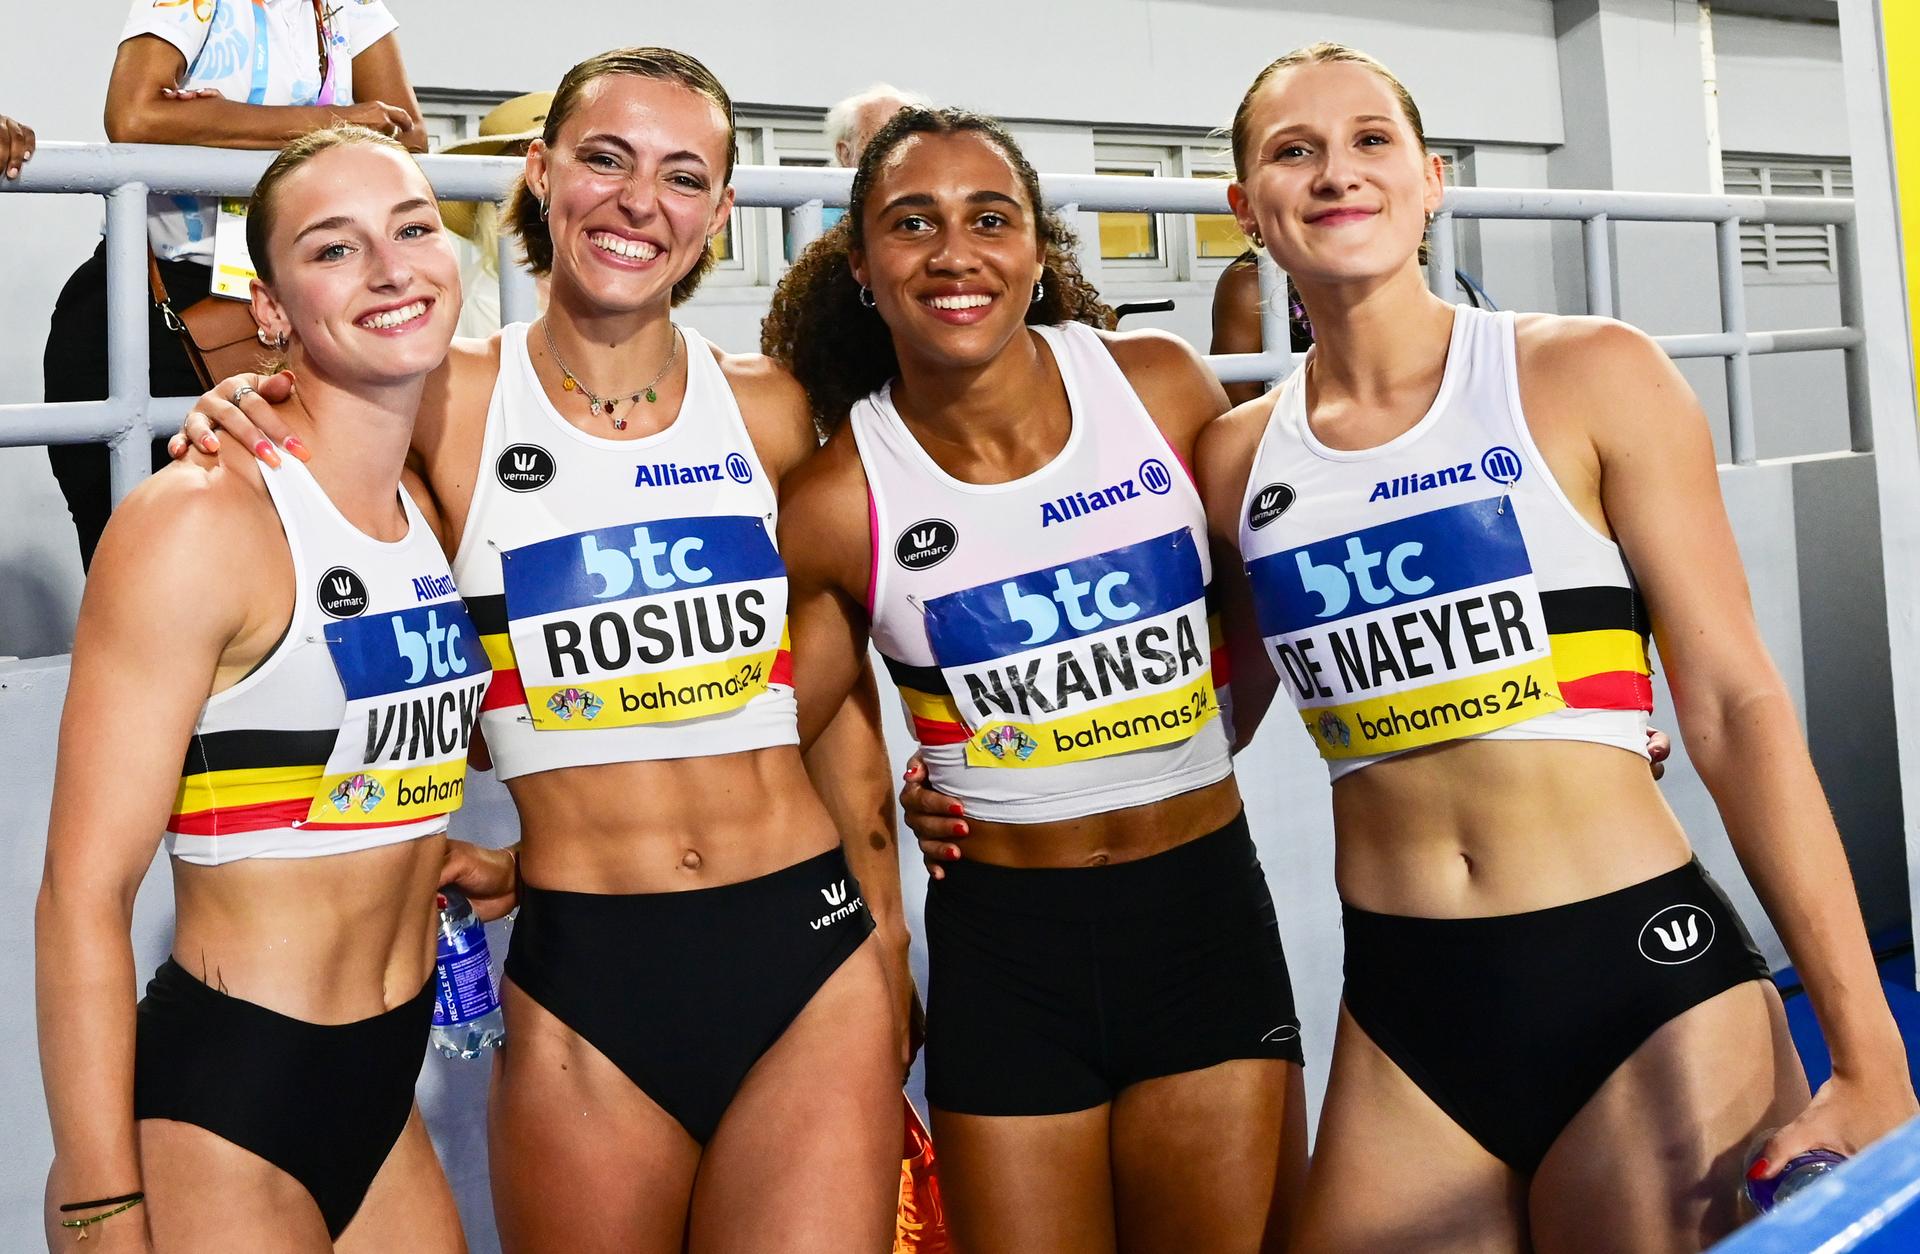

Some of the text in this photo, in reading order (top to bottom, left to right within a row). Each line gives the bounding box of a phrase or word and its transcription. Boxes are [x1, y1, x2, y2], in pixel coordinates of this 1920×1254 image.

[503, 471, 545, 483] vermarc
[634, 461, 724, 488] Allianz
[1040, 479, 1140, 528] Allianz
[1369, 462, 1476, 503] Allianz
[580, 526, 713, 599] btc
[904, 544, 948, 562] vermarc
[1294, 536, 1435, 618] btc
[327, 597, 364, 609] vermarc
[411, 574, 457, 602] Allianz
[1002, 568, 1141, 645] btc
[391, 609, 468, 685] btc
[542, 589, 766, 678] ROSIUS
[1275, 590, 1535, 700] DE NAEYER
[963, 614, 1204, 718] NKANSA
[437, 964, 459, 1022] RECYCLE ME
